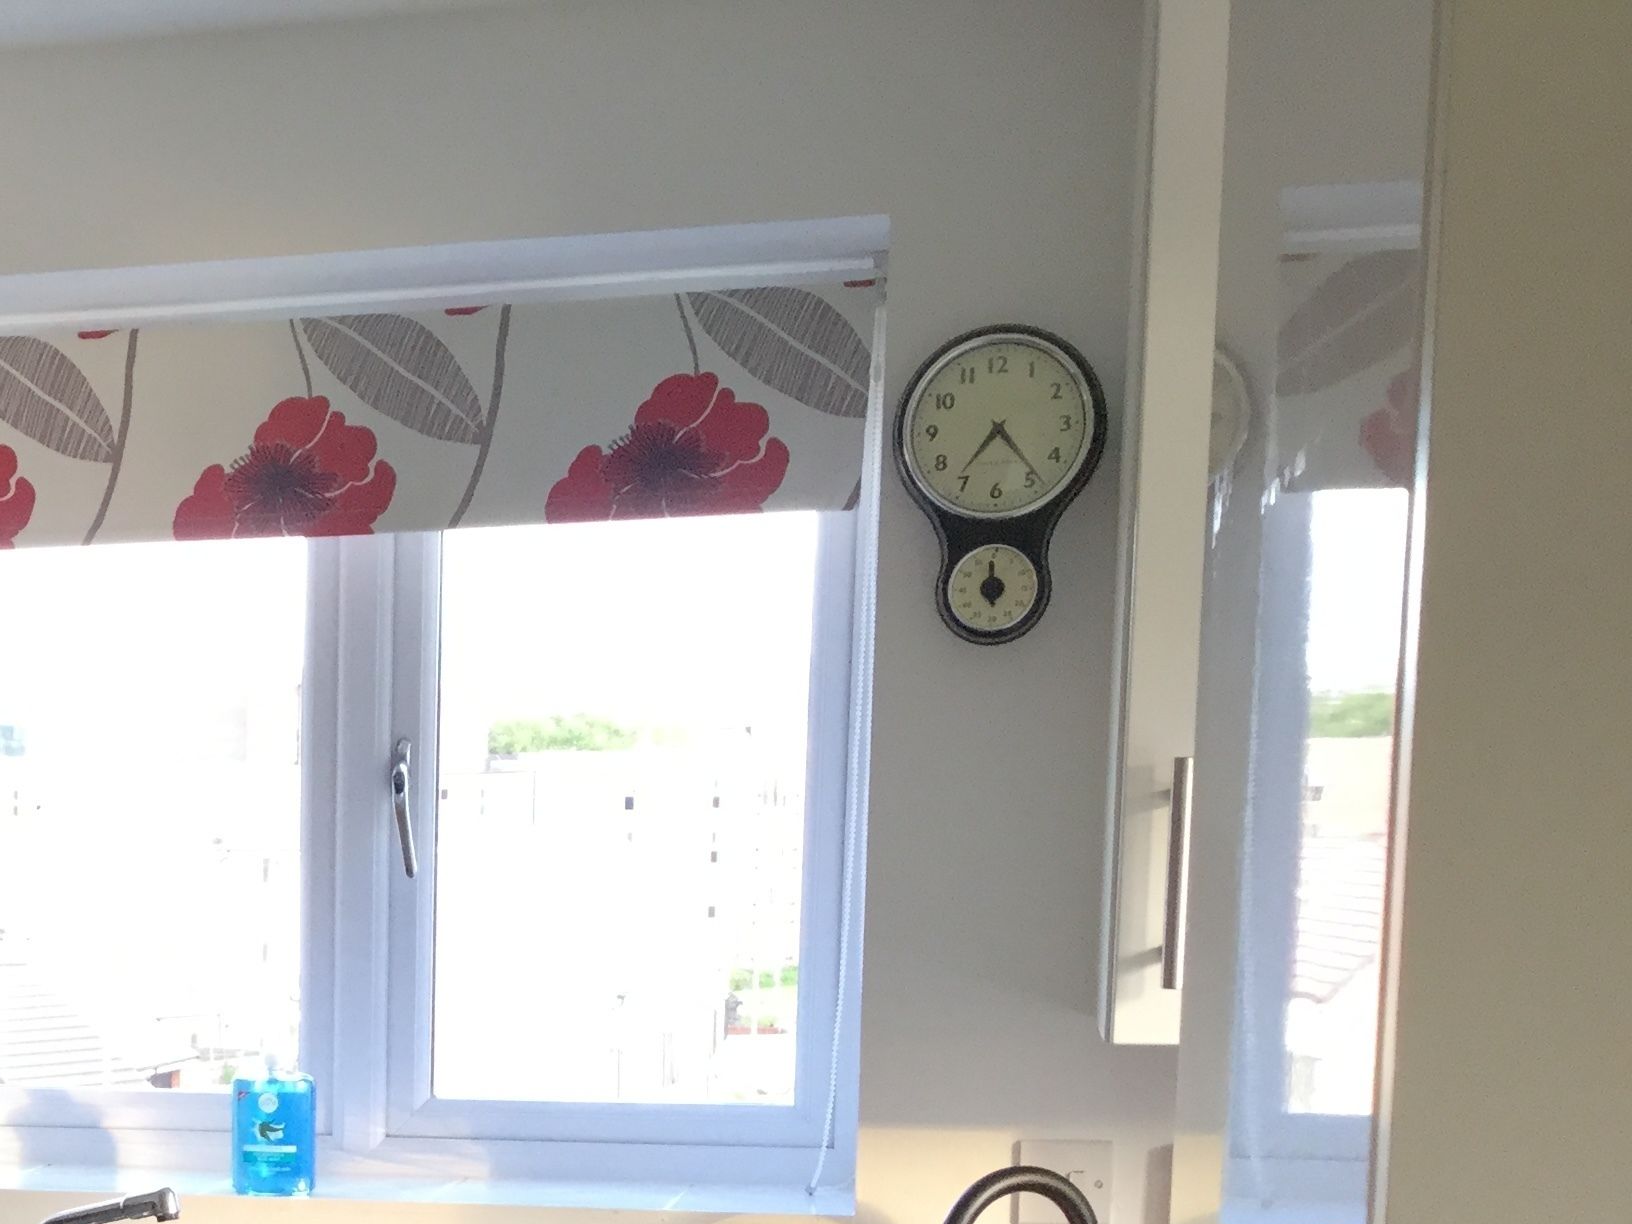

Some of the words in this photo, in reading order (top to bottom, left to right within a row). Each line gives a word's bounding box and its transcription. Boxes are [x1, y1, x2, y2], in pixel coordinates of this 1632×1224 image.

[987, 355, 1009, 374] 12
[1028, 361, 1036, 378] 1
[960, 367, 975, 384] 11
[1050, 382, 1063, 400] 2
[936, 392, 955, 410] 10
[1059, 414, 1072, 432] 3
[925, 424, 939, 442] 9
[934, 454, 948, 472] 8
[1047, 447, 1061, 464] 4
[957, 475, 970, 492] 7
[1023, 471, 1037, 489] 5
[989, 482, 1003, 499] 6
